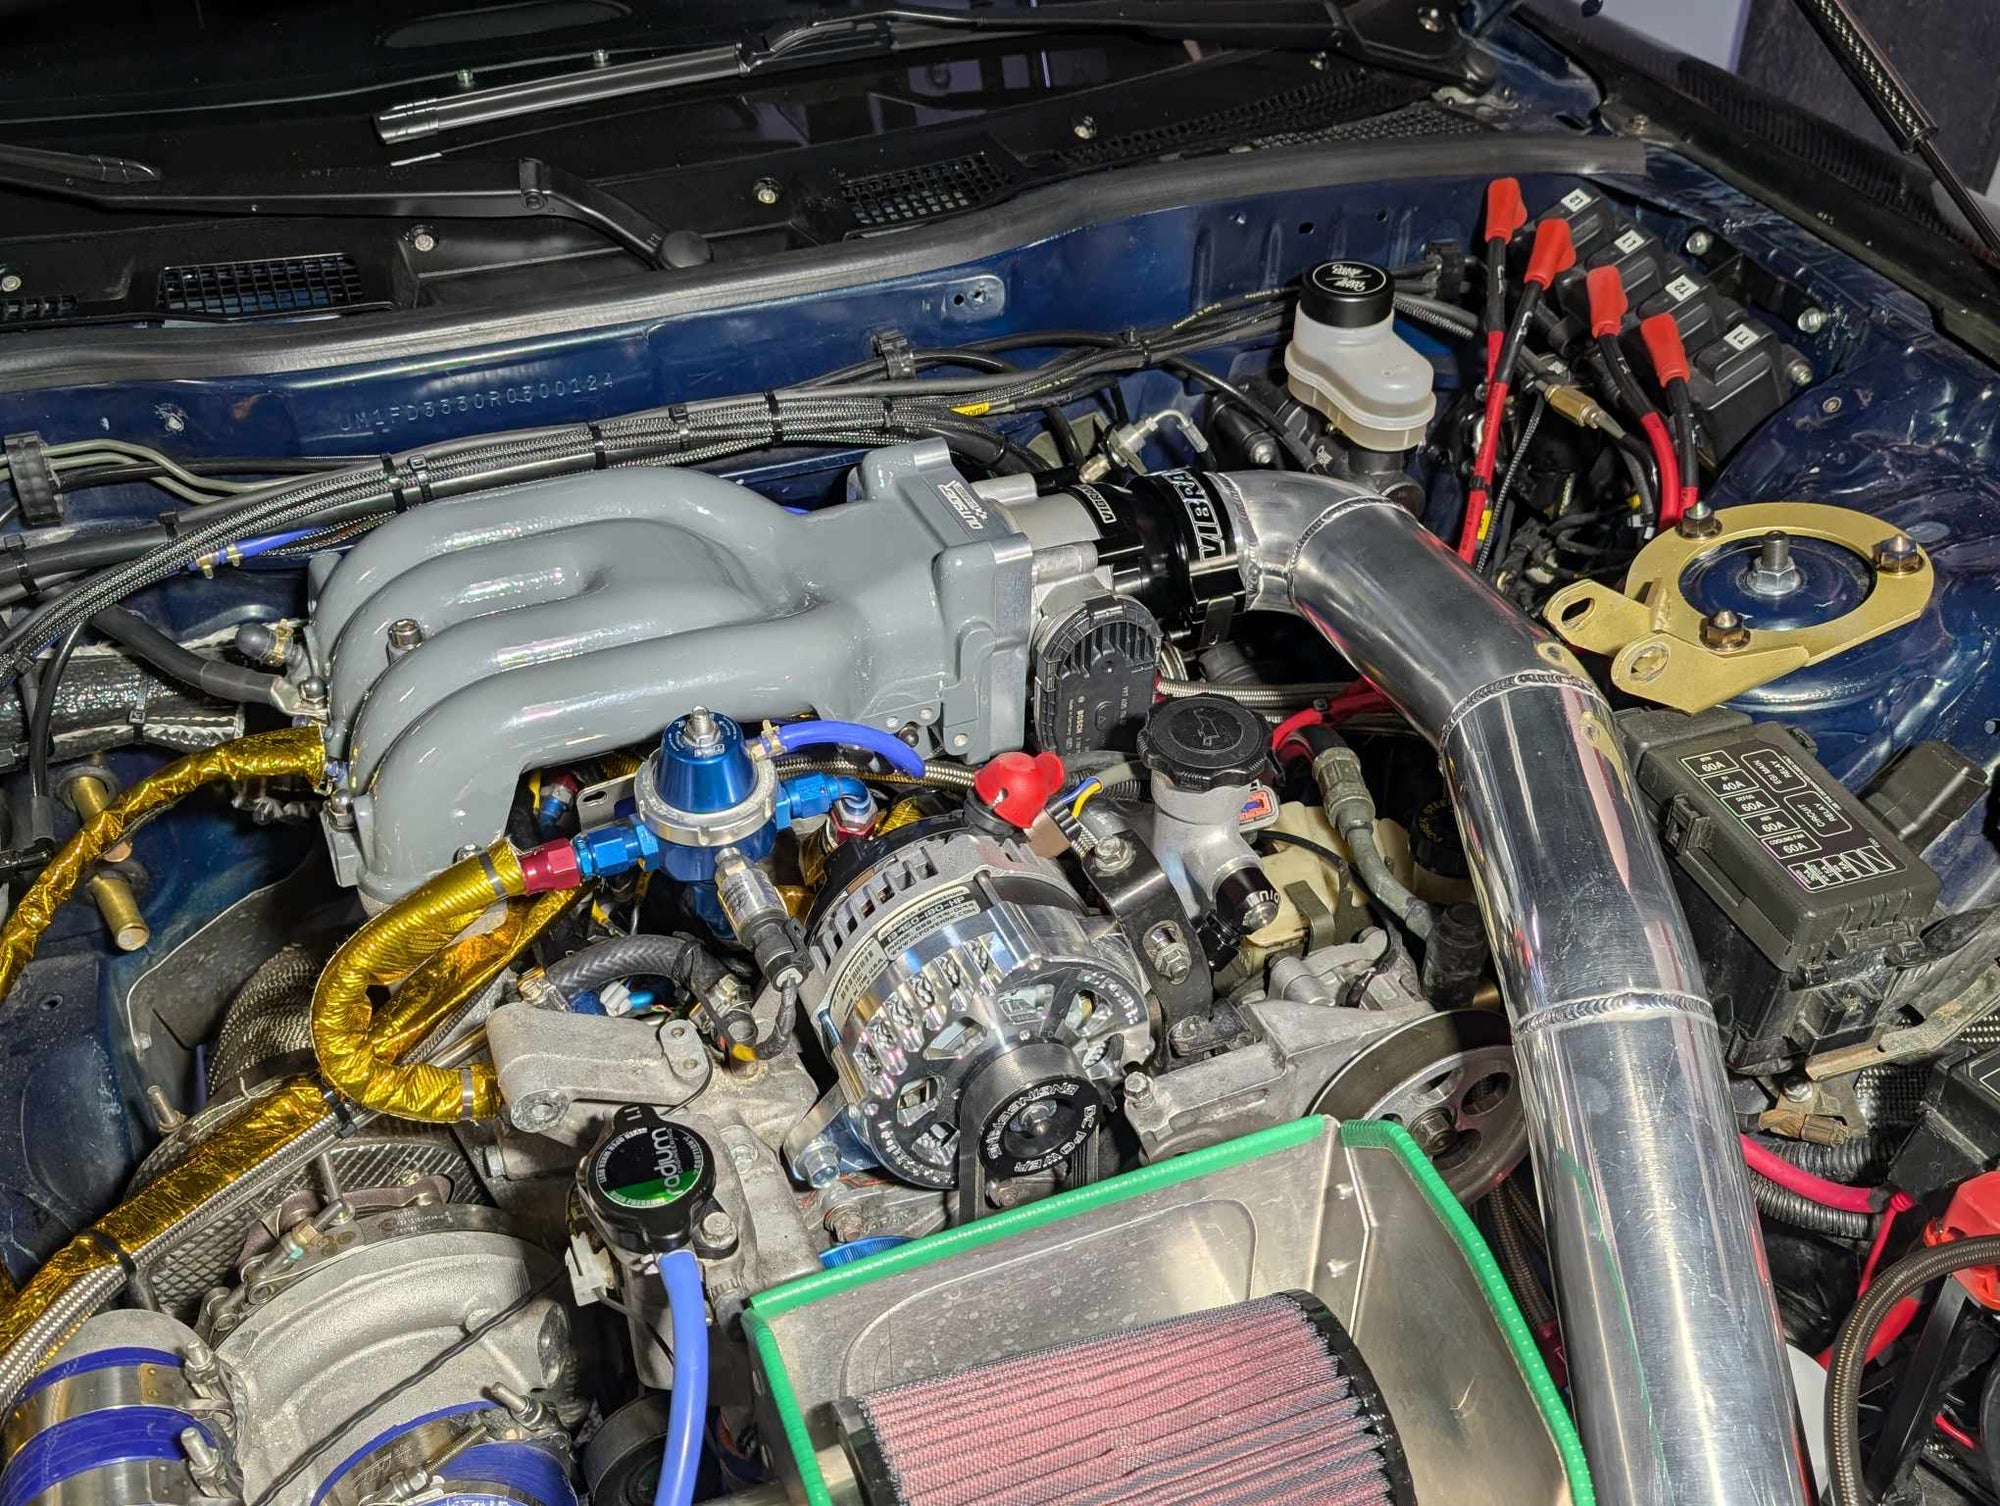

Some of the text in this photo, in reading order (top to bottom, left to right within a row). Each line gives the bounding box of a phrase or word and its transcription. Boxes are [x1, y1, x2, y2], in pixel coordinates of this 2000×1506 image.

[1569, 195, 1584, 208] L2
[1622, 236, 1637, 249] L1
[1674, 282, 1690, 295] T2
[1733, 331, 1750, 344] T1
[1161, 468, 1226, 562] VIBRA
[1701, 761, 1726, 773] 60A
[1770, 760, 1793, 779] RELAY
[1722, 780, 1747, 792] 40A
[1741, 800, 1767, 812] 60A
[1813, 802, 1839, 823] RELAY
[1796, 803, 1826, 828] CIRCUIT
[1761, 821, 1788, 833] 60A
[1782, 842, 1809, 854] 60A
[985, 1081, 1080, 1160] ENGINEERING
[1013, 1130, 1087, 1173] POWER
[651, 1127, 685, 1196] radium
